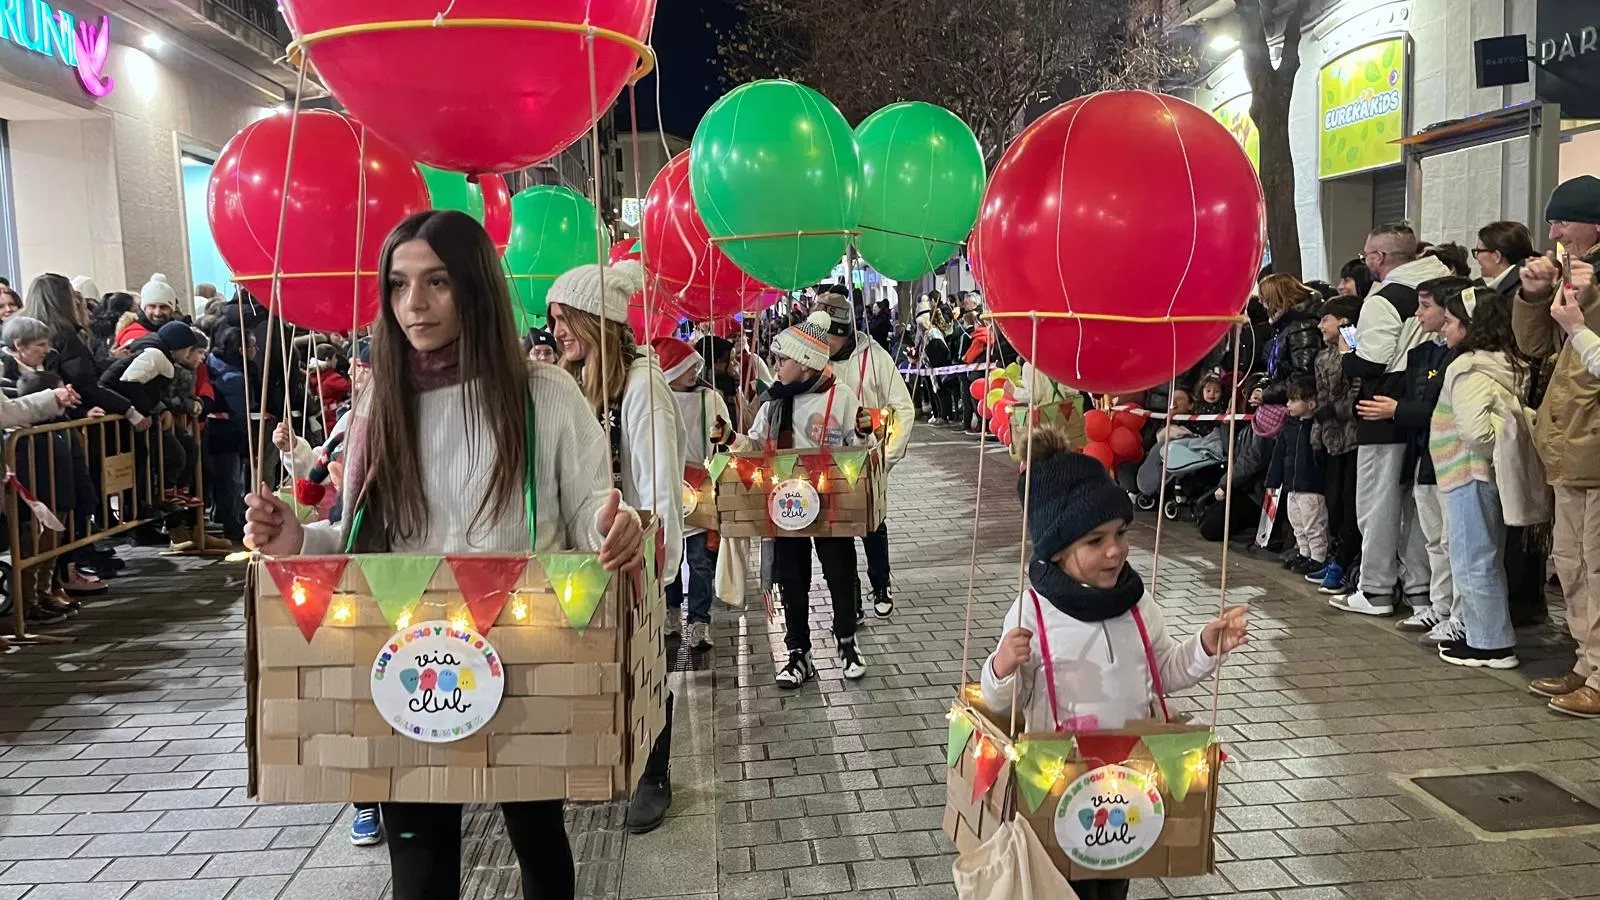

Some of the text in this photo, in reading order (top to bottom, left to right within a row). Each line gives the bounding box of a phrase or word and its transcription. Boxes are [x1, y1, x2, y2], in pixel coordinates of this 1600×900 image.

[781, 507, 807, 518] club
[414, 650, 461, 667] via
[408, 688, 472, 713] club
[1090, 792, 1130, 807] via
[1084, 823, 1136, 846] club
